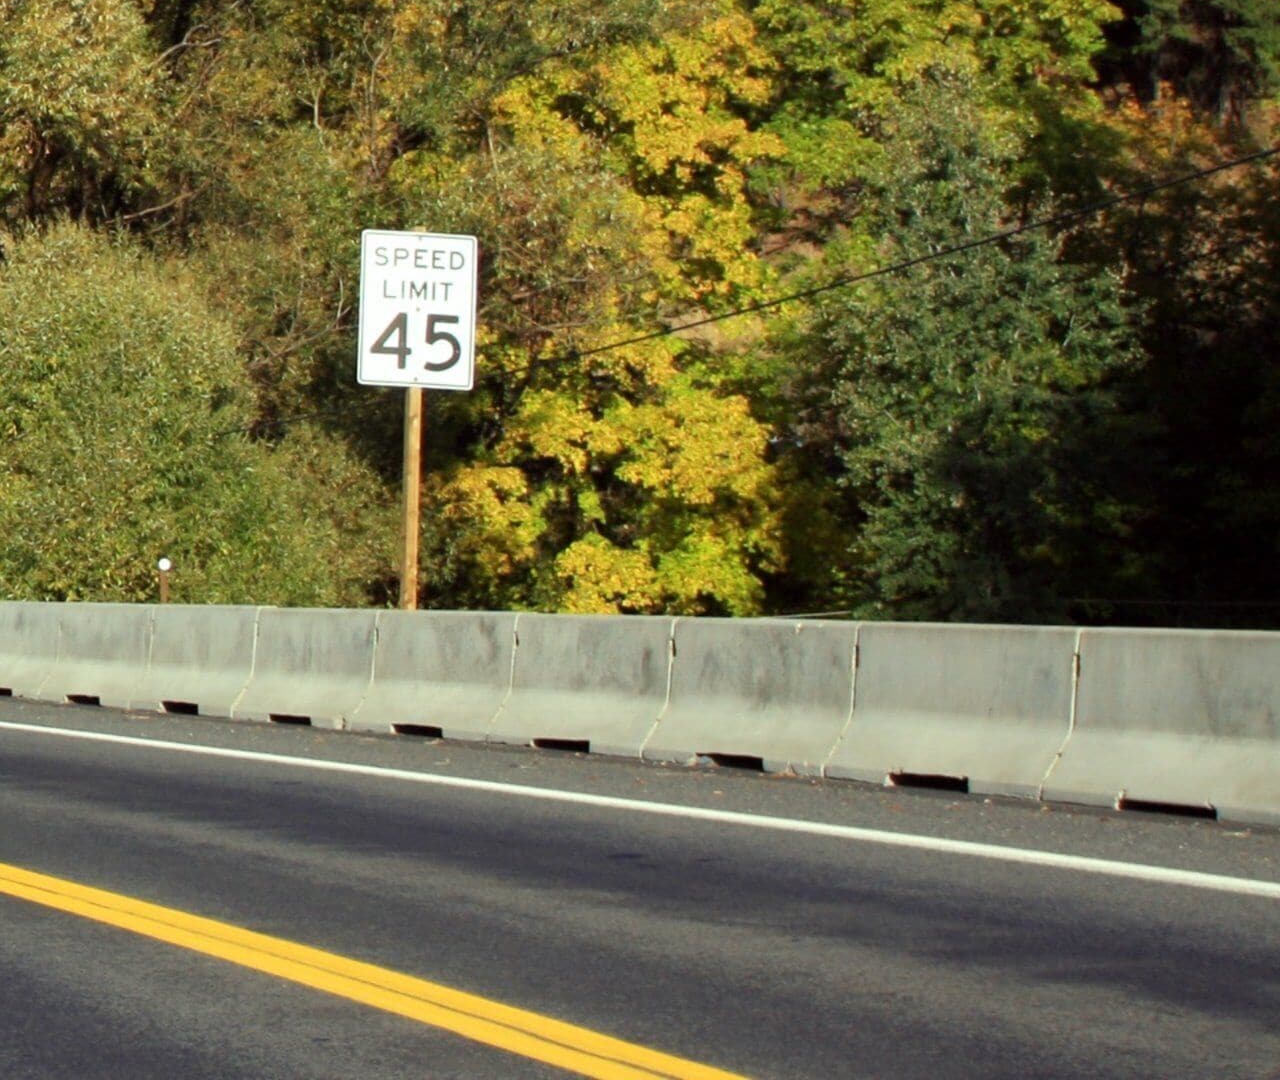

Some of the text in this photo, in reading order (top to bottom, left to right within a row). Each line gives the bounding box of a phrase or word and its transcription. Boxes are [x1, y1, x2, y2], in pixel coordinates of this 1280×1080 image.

[374, 247, 465, 270] SPEED
[383, 279, 453, 301] LIMIT
[370, 312, 462, 372] 45
